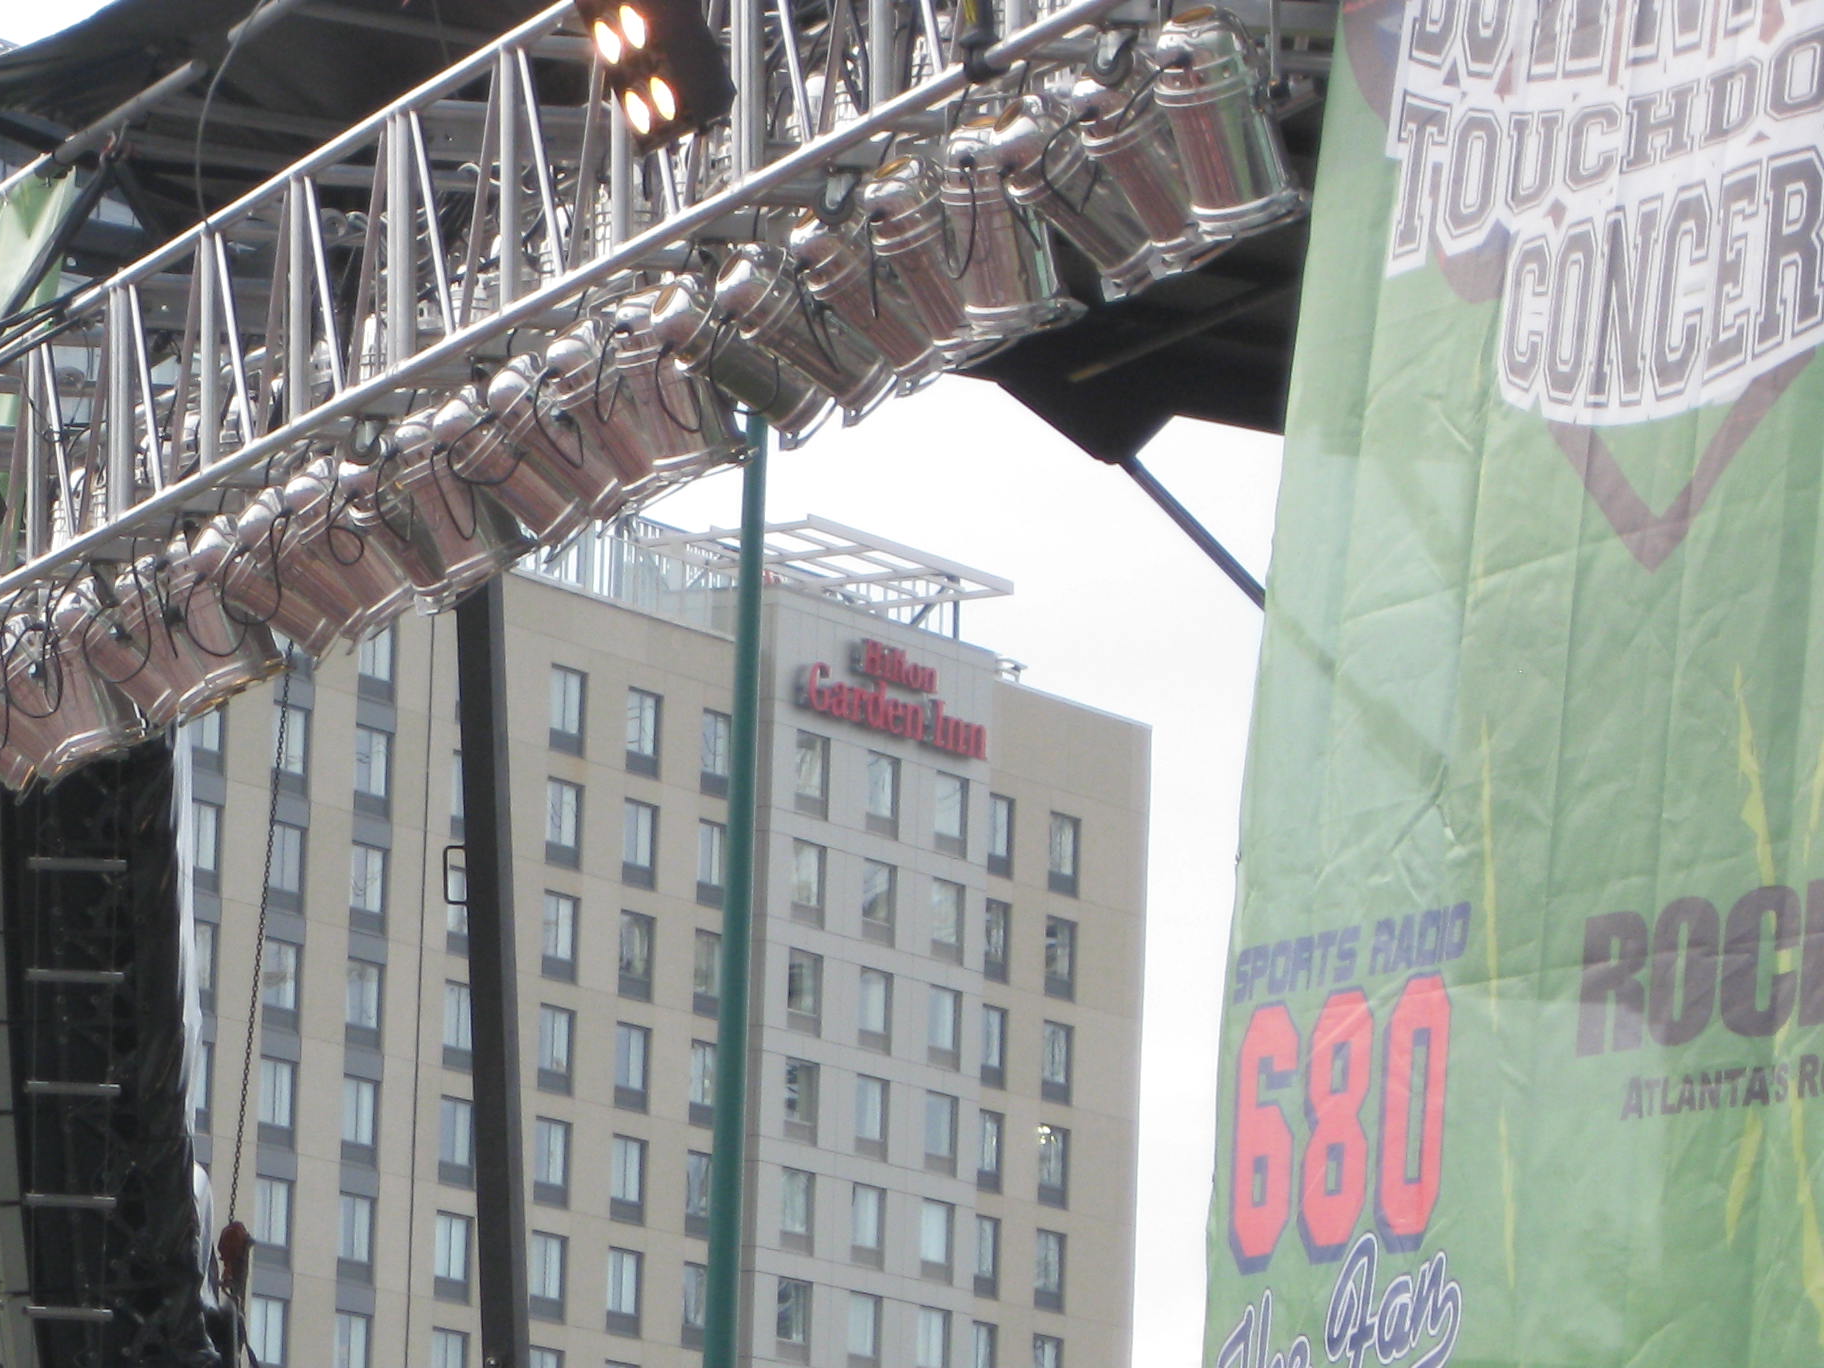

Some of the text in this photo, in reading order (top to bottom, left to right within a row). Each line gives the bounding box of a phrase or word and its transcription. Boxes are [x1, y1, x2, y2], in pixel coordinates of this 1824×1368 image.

[807, 661, 987, 761] Garden Inn
[862, 638, 938, 694] Hilton
[1232, 901, 1473, 1004] SPORTS RADIO
[1228, 972, 1452, 1275] 680
